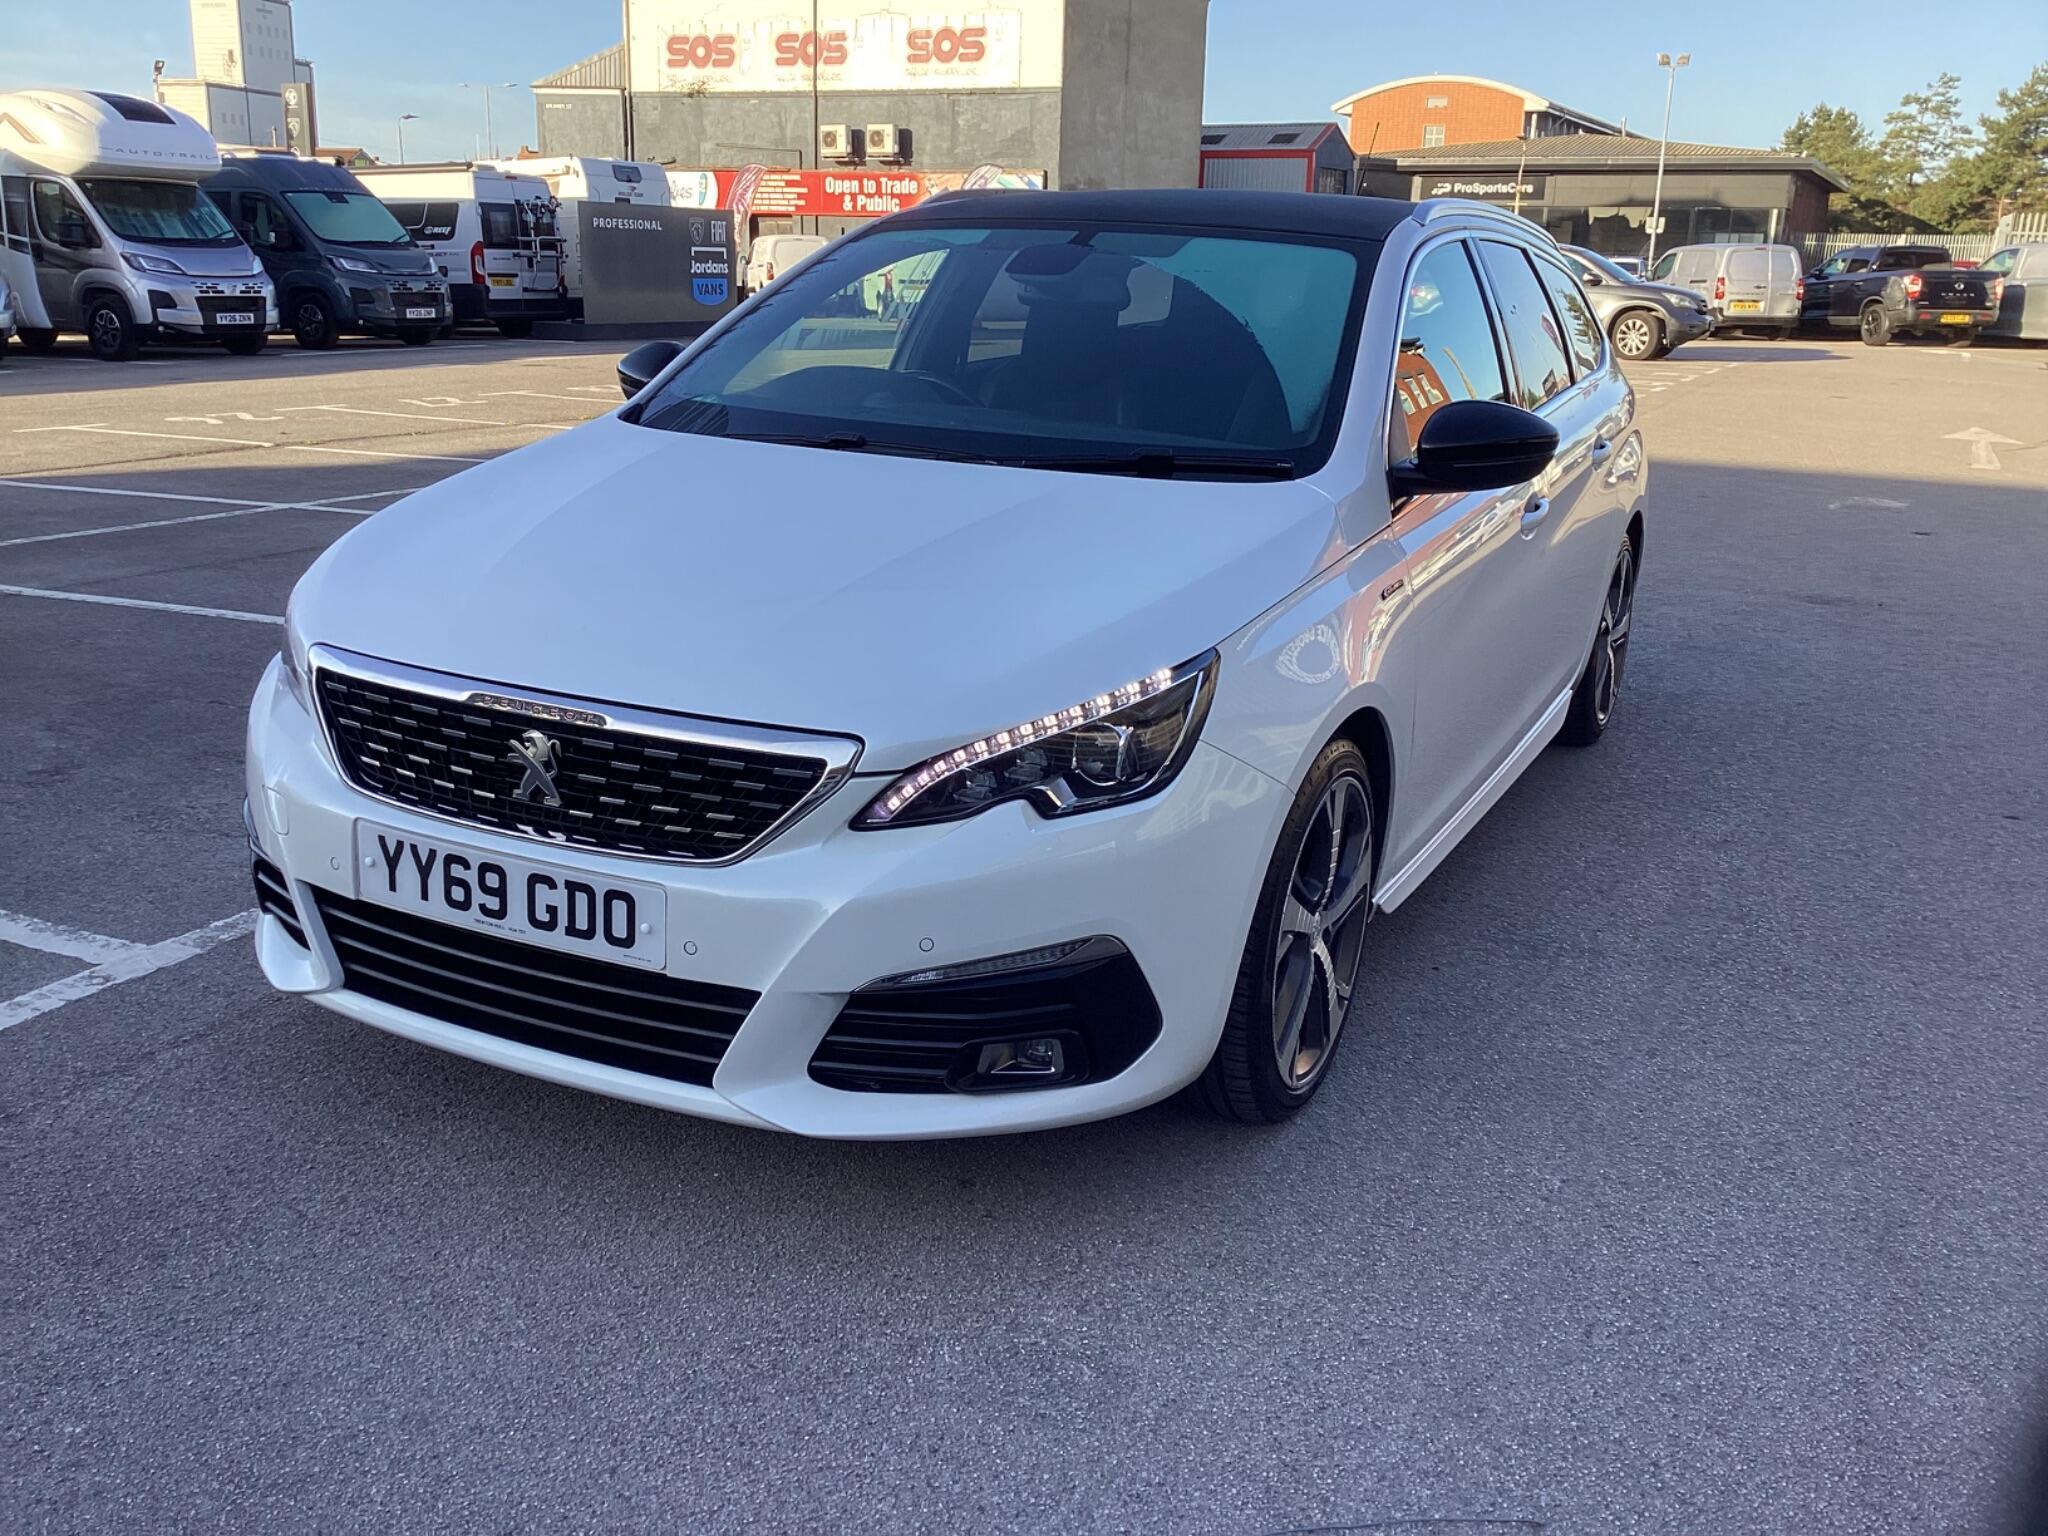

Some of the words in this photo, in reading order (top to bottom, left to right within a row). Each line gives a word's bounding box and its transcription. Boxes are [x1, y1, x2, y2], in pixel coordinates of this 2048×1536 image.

[666, 34, 735, 69] SOS
[775, 31, 848, 67] SOS
[906, 26, 987, 63] SOS
[825, 176, 862, 196] Open
[863, 177, 877, 194] to
[879, 176, 918, 194] Trade
[842, 195, 853, 213] &
[856, 195, 900, 213] Public
[592, 217, 663, 231] PROFESSIONAL
[710, 220, 727, 243] FIAT
[690, 260, 729, 275] Jordans
[696, 283, 724, 296] VANS
[483, 695, 594, 722] PEUGEOT
[377, 834, 508, 921] YY69
[526, 872, 636, 950] GDO
